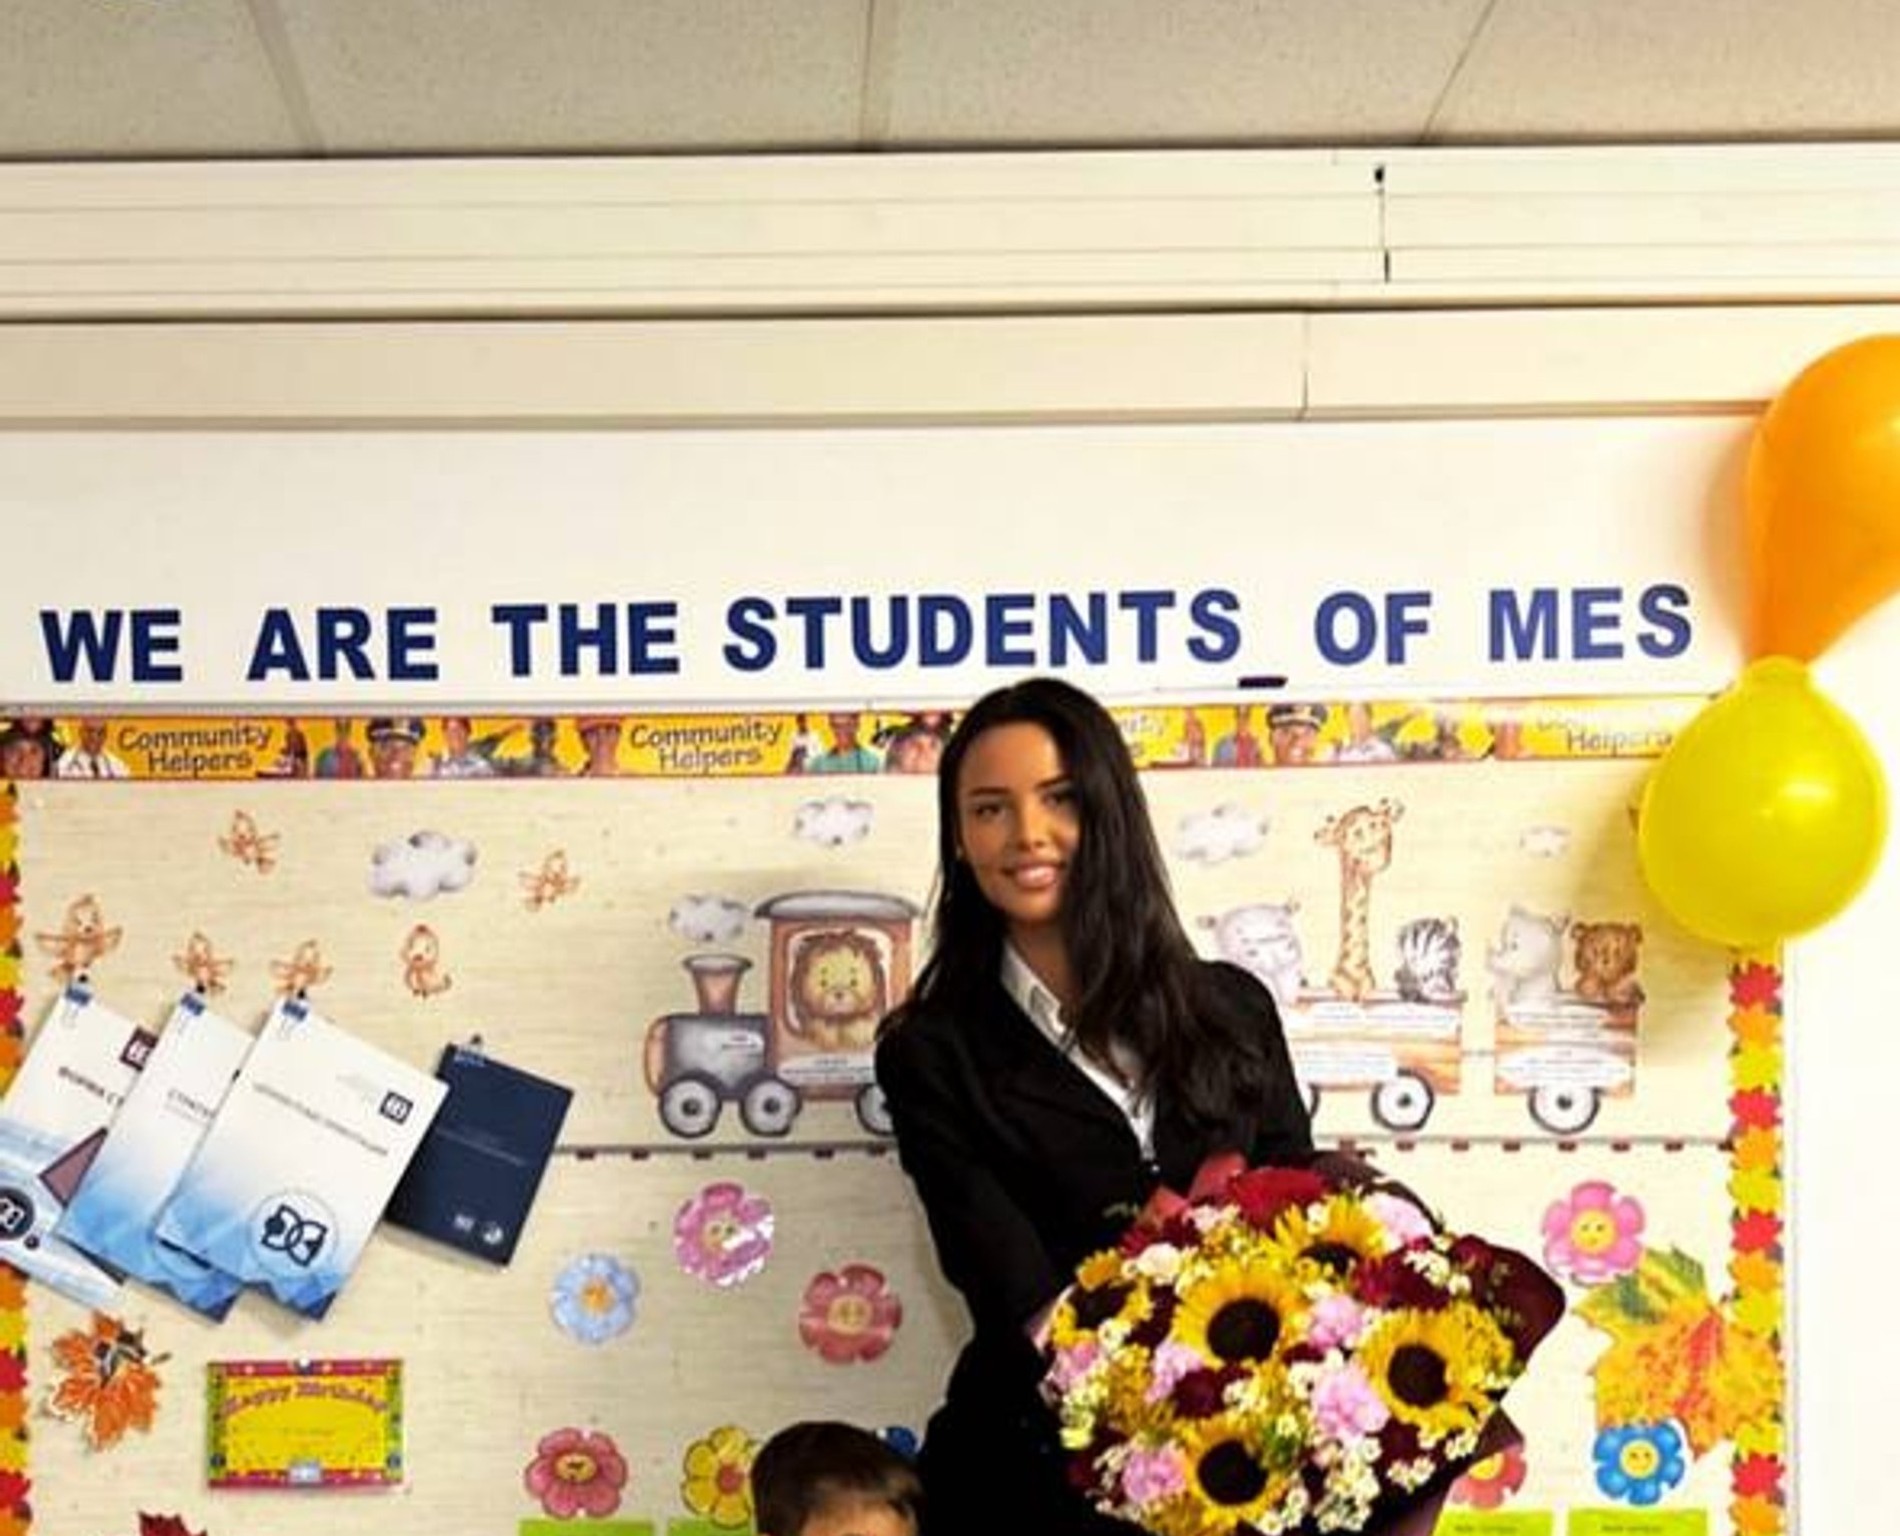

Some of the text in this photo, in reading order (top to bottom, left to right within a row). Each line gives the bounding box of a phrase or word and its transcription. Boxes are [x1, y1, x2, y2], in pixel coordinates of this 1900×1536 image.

[39, 584, 1692, 683] WE ARE THE STUDENTS OF MES
[119, 720, 273, 751] Community
[630, 720, 784, 750] Community
[149, 748, 253, 779] Helpers
[660, 745, 763, 774] Helpers
